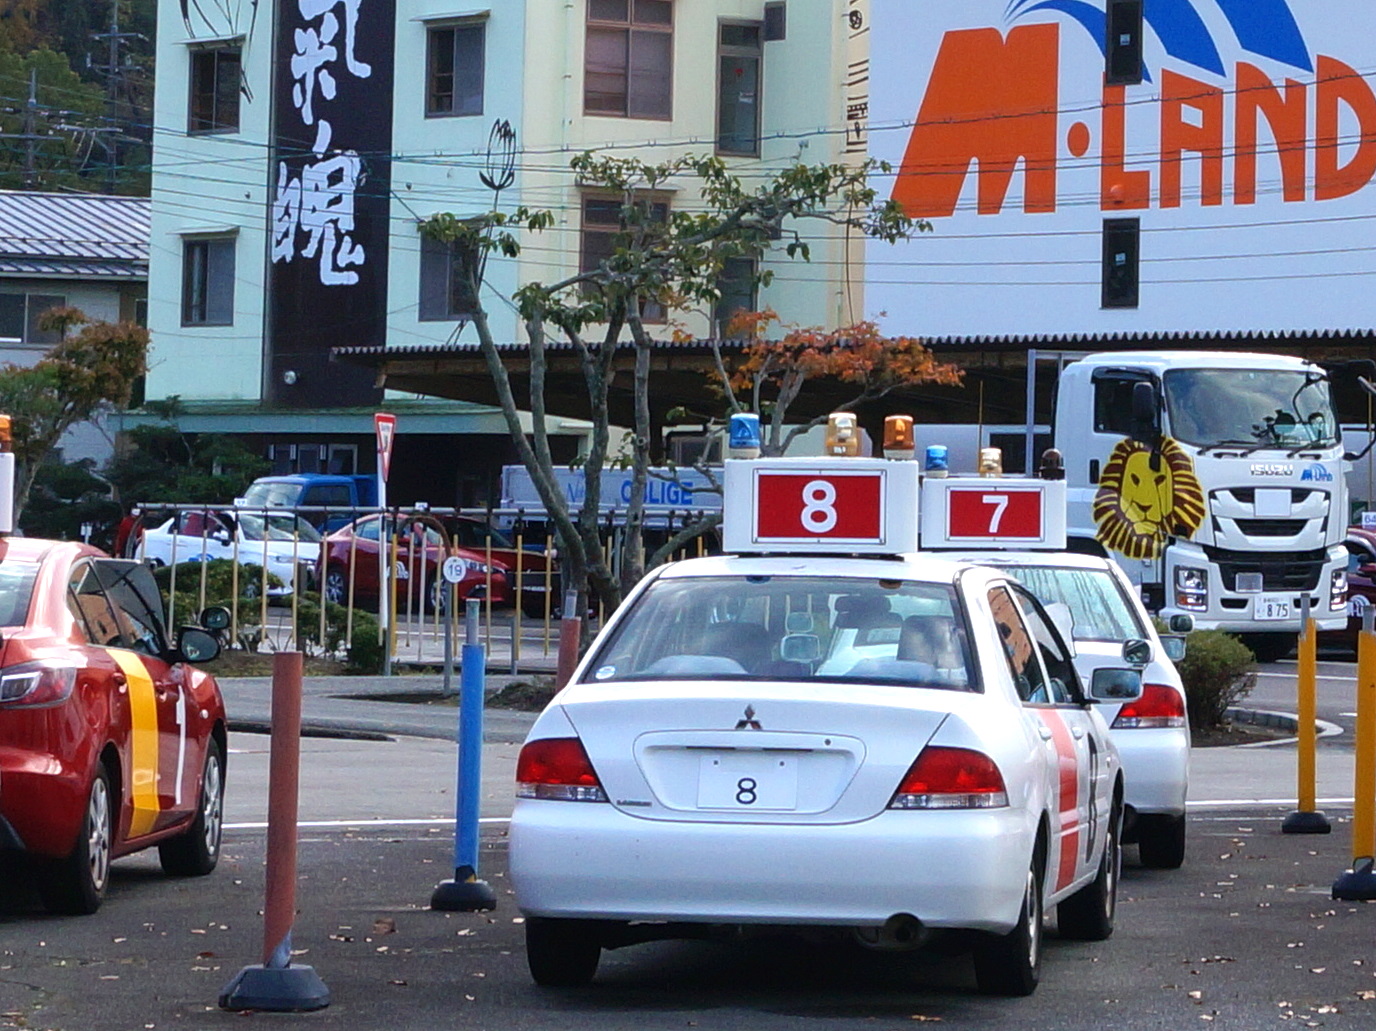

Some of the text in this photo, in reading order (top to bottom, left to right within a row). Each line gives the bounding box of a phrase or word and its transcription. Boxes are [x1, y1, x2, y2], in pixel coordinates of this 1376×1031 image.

[1250, 464, 1294, 476] ISUZU
[621, 481, 693, 505] OLIGE
[800, 480, 838, 533] 8
[982, 494, 1009, 534] 7
[1364, 514, 1376, 523] 64
[449, 564, 462, 578] 19
[735, 777, 758, 805] 8
